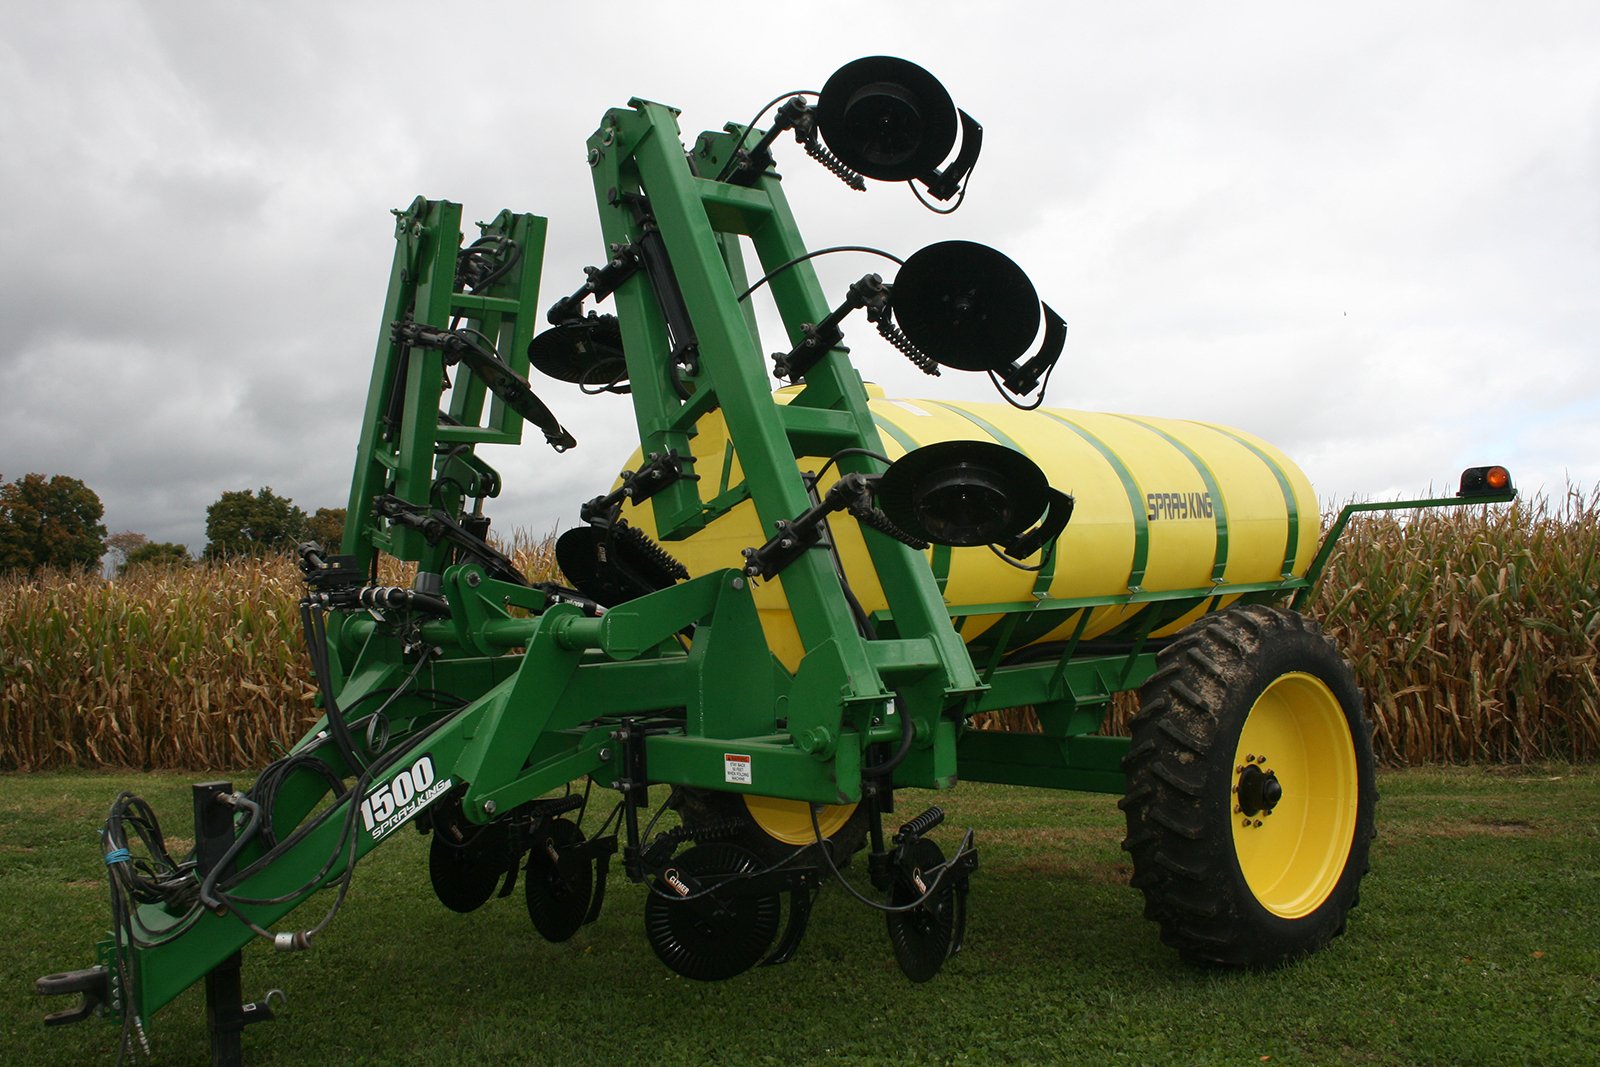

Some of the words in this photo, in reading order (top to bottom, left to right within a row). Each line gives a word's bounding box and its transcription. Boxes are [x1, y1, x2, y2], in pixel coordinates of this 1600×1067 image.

[1147, 493, 1187, 521] SPRAY
[1188, 492, 1213, 519] KING
[360, 756, 434, 832] 1500
[371, 800, 416, 840] SPRAY
[417, 779, 447, 806] KING
